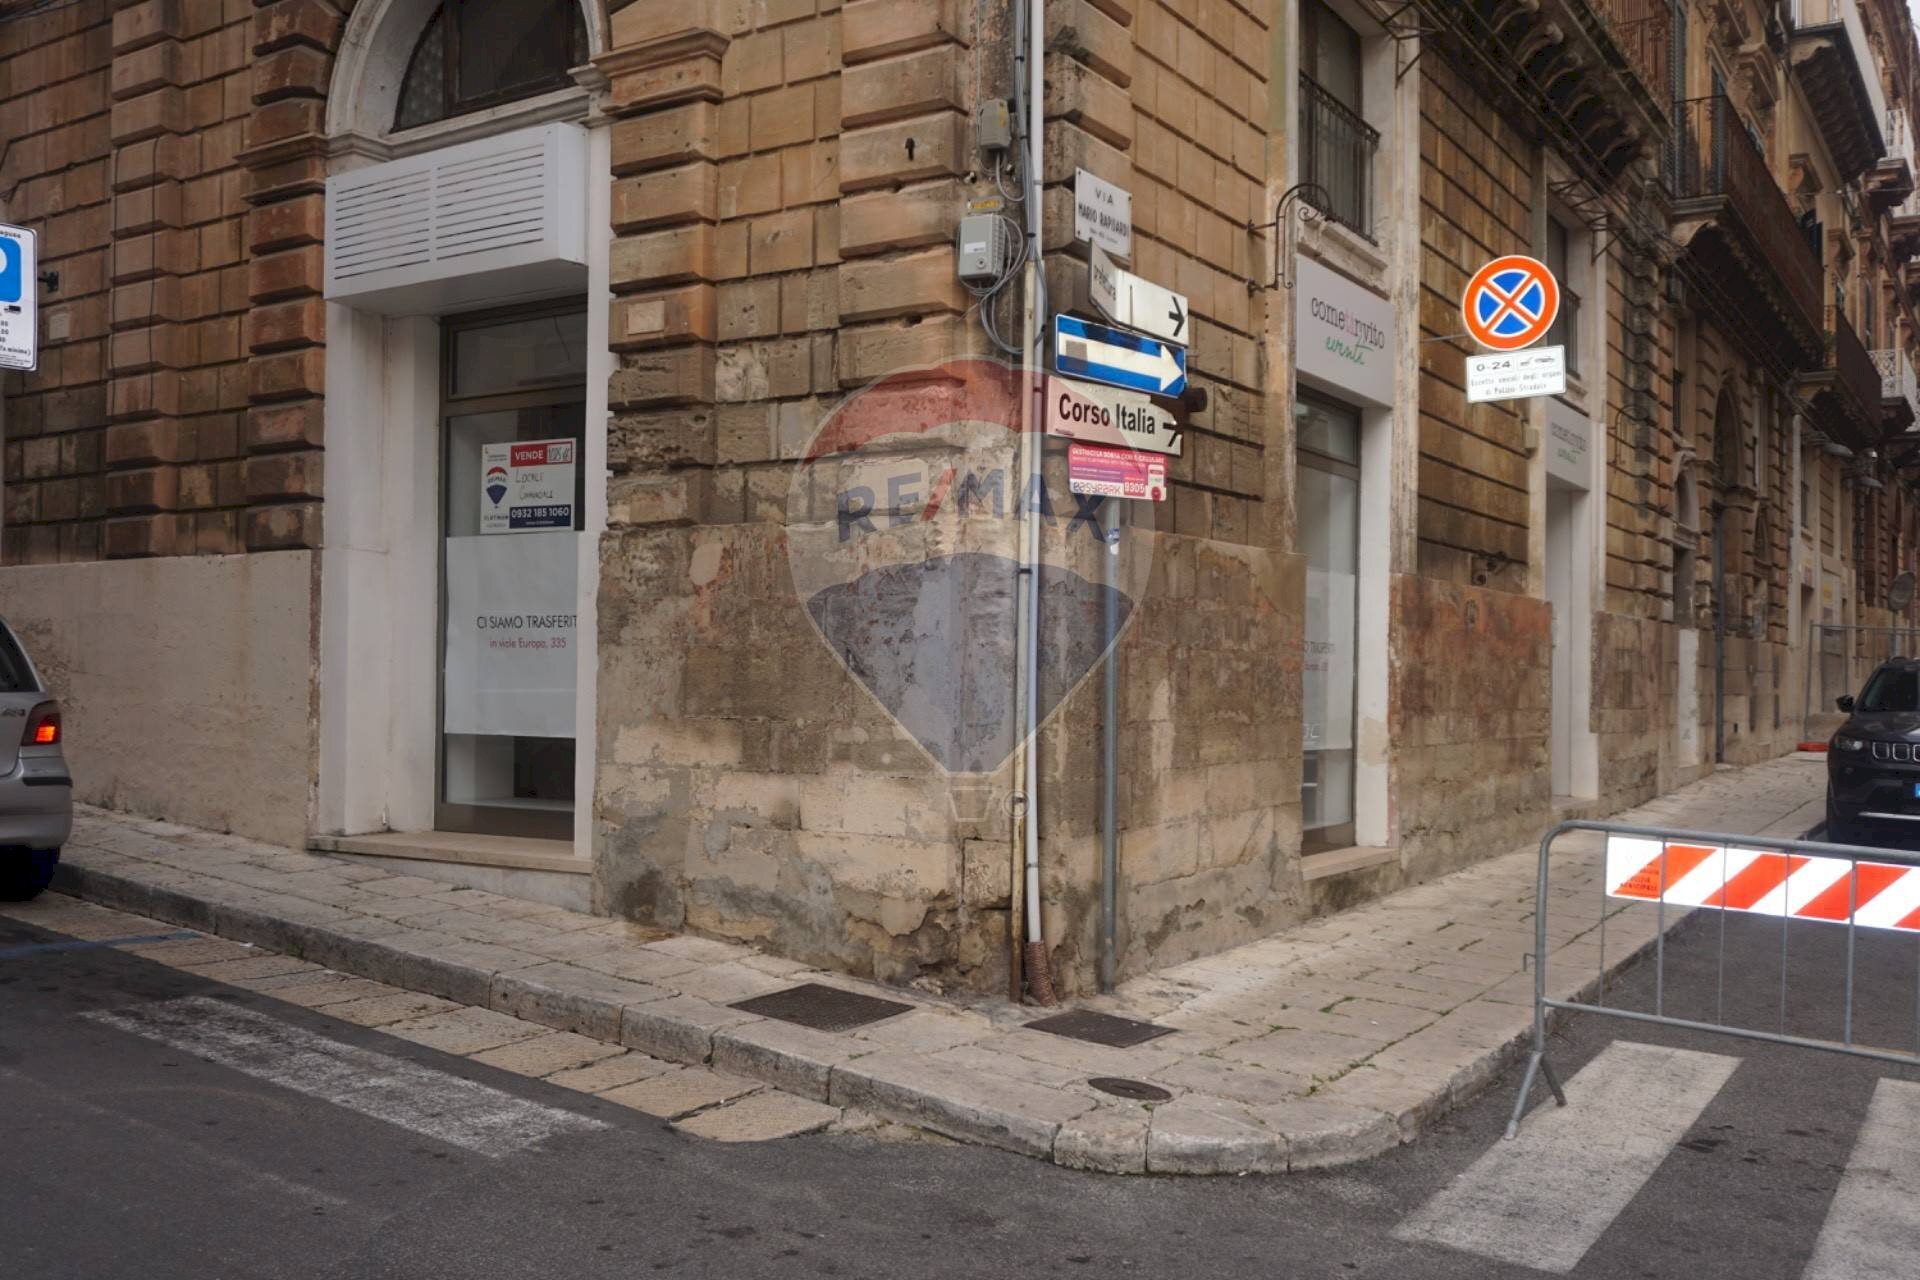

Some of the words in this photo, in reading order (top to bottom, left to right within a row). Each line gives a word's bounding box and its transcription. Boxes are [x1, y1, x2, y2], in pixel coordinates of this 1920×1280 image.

[1095, 187, 1113, 206] VIA
[1059, 393, 1110, 426] Corso
[1115, 403, 1155, 434] Italia
[515, 450, 544, 460] VENDE
[511, 508, 532, 518] 0932
[490, 616, 523, 629] SIAMO
